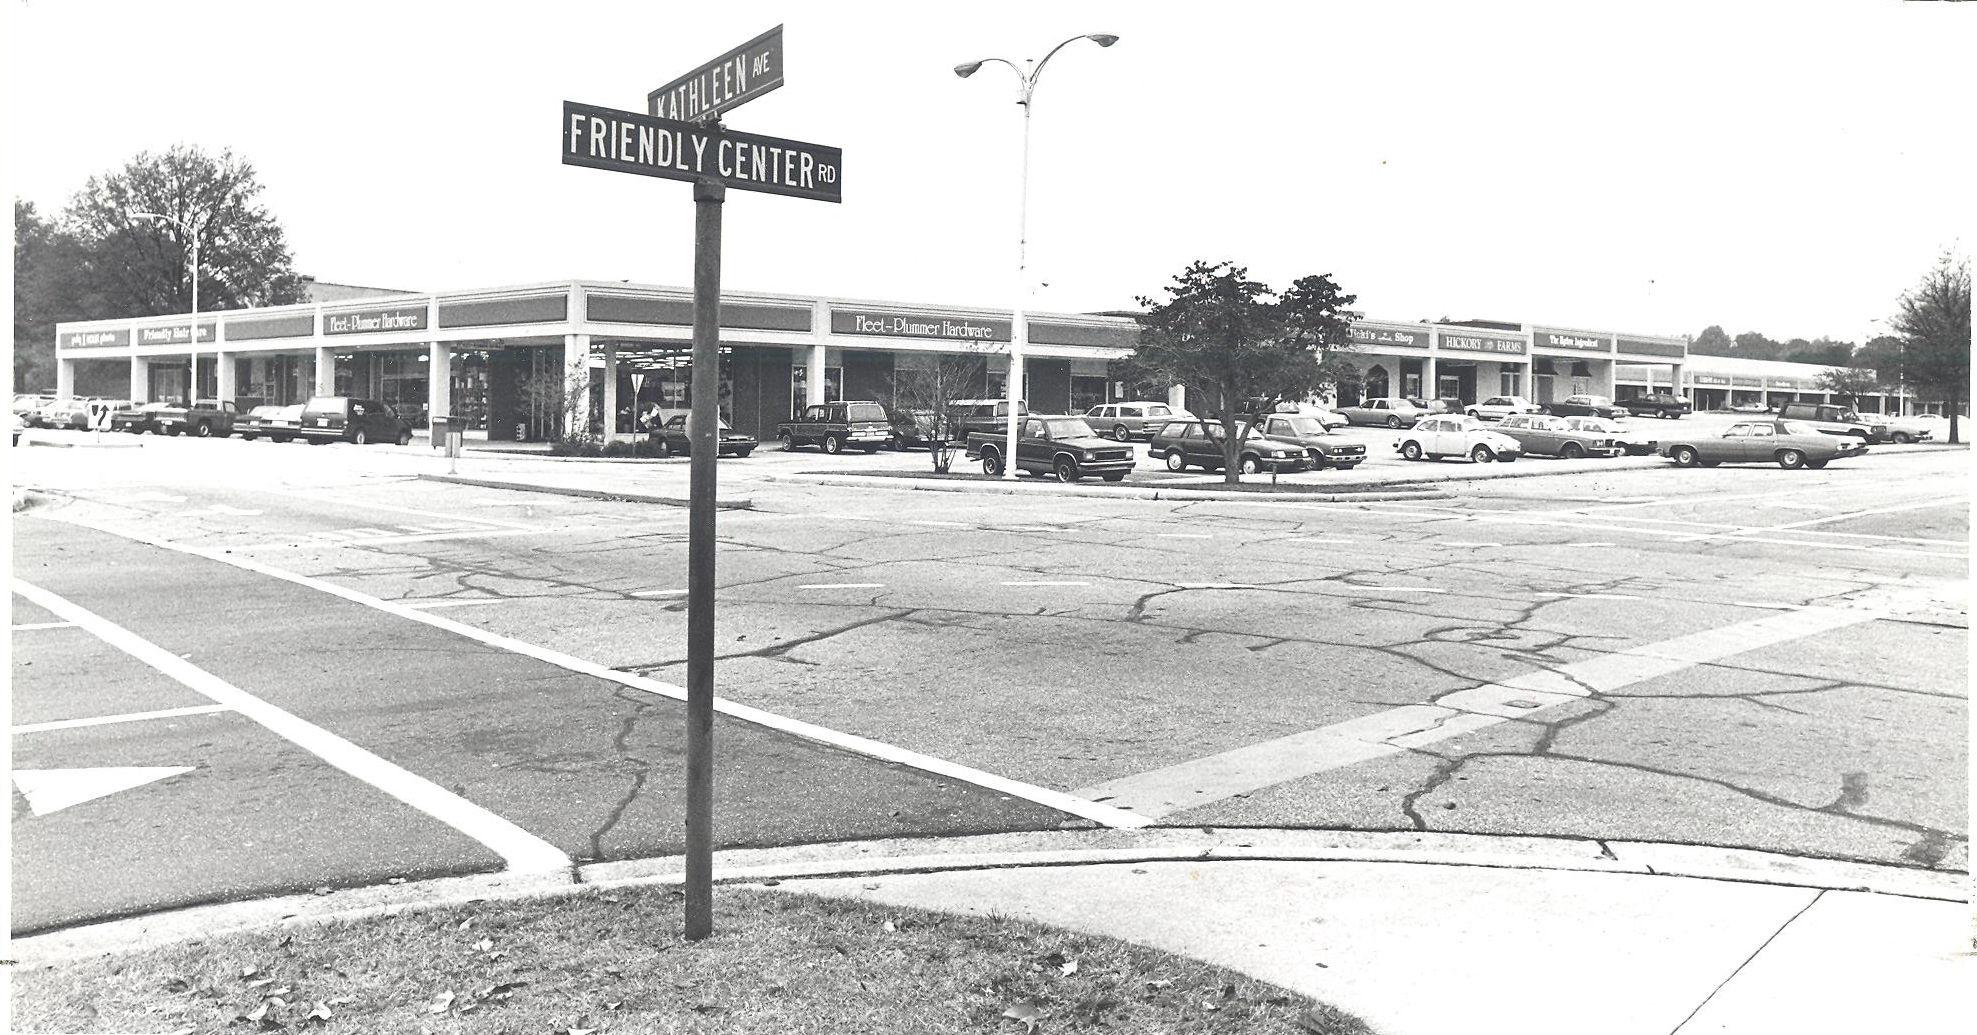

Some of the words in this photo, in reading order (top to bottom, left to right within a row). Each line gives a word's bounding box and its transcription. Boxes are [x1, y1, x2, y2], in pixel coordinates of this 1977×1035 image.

[657, 55, 746, 121] KATHLEEN
[752, 52, 770, 77] AVE
[570, 113, 708, 173] FRIENDLY
[718, 139, 814, 189] CENTER
[818, 163, 836, 184] RD
[855, 315, 940, 335] Fleet-Plummer
[942, 321, 992, 338] Hardware
[1394, 332, 1414, 344] Shop
[1446, 336, 1482, 350] HICKORY
[1497, 340, 1521, 351] FARMS
